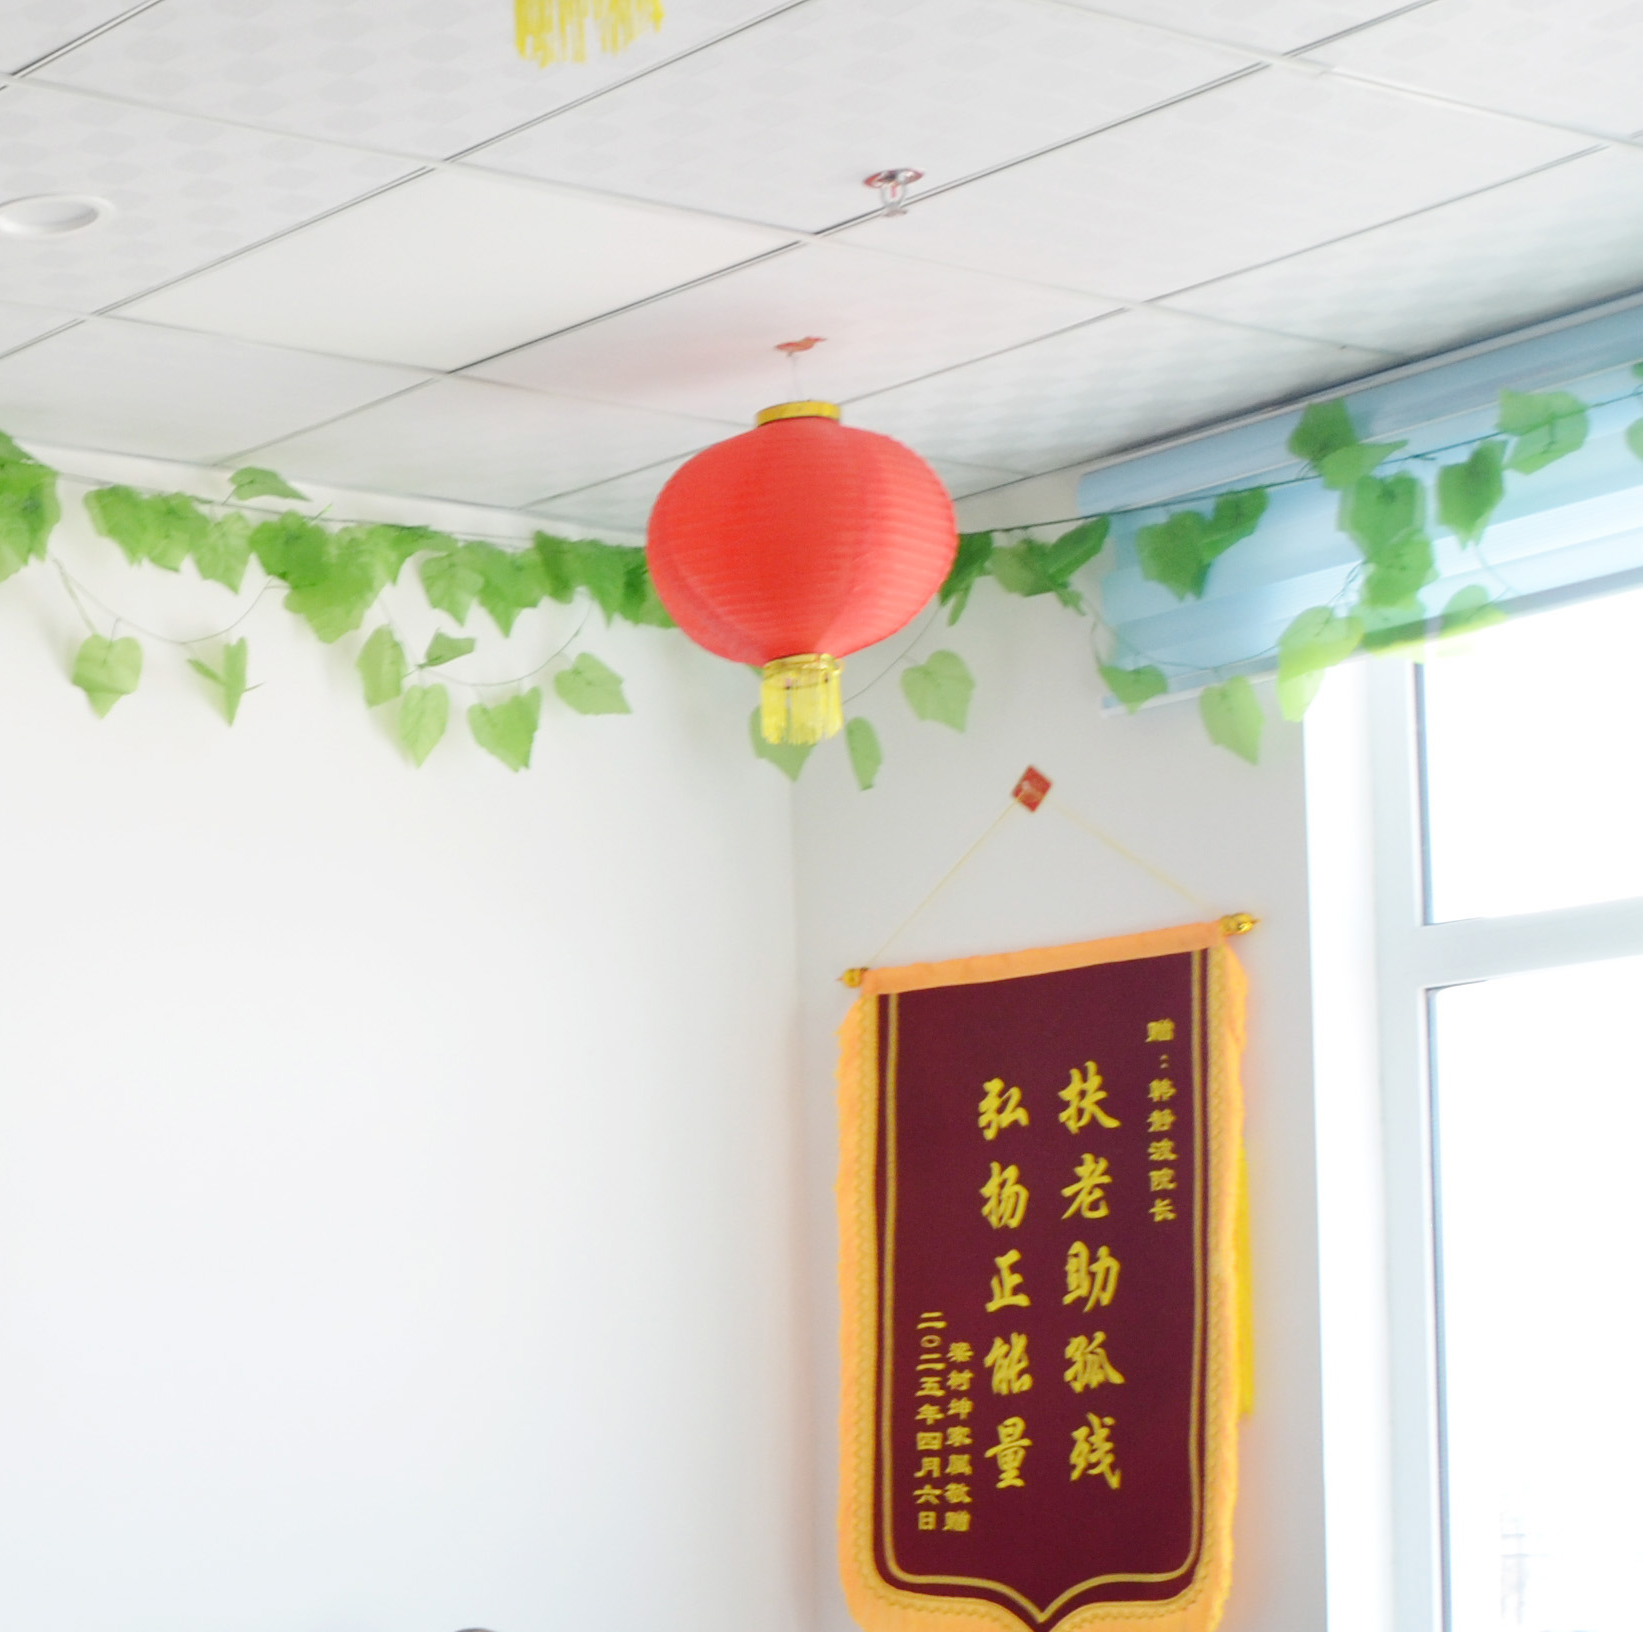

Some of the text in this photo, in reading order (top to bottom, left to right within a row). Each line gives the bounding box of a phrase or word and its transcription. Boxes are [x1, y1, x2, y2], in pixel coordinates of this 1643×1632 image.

[978, 1077, 1033, 1490] 弘扬正能量
[1058, 1060, 1125, 1490] 扶老助孤残
